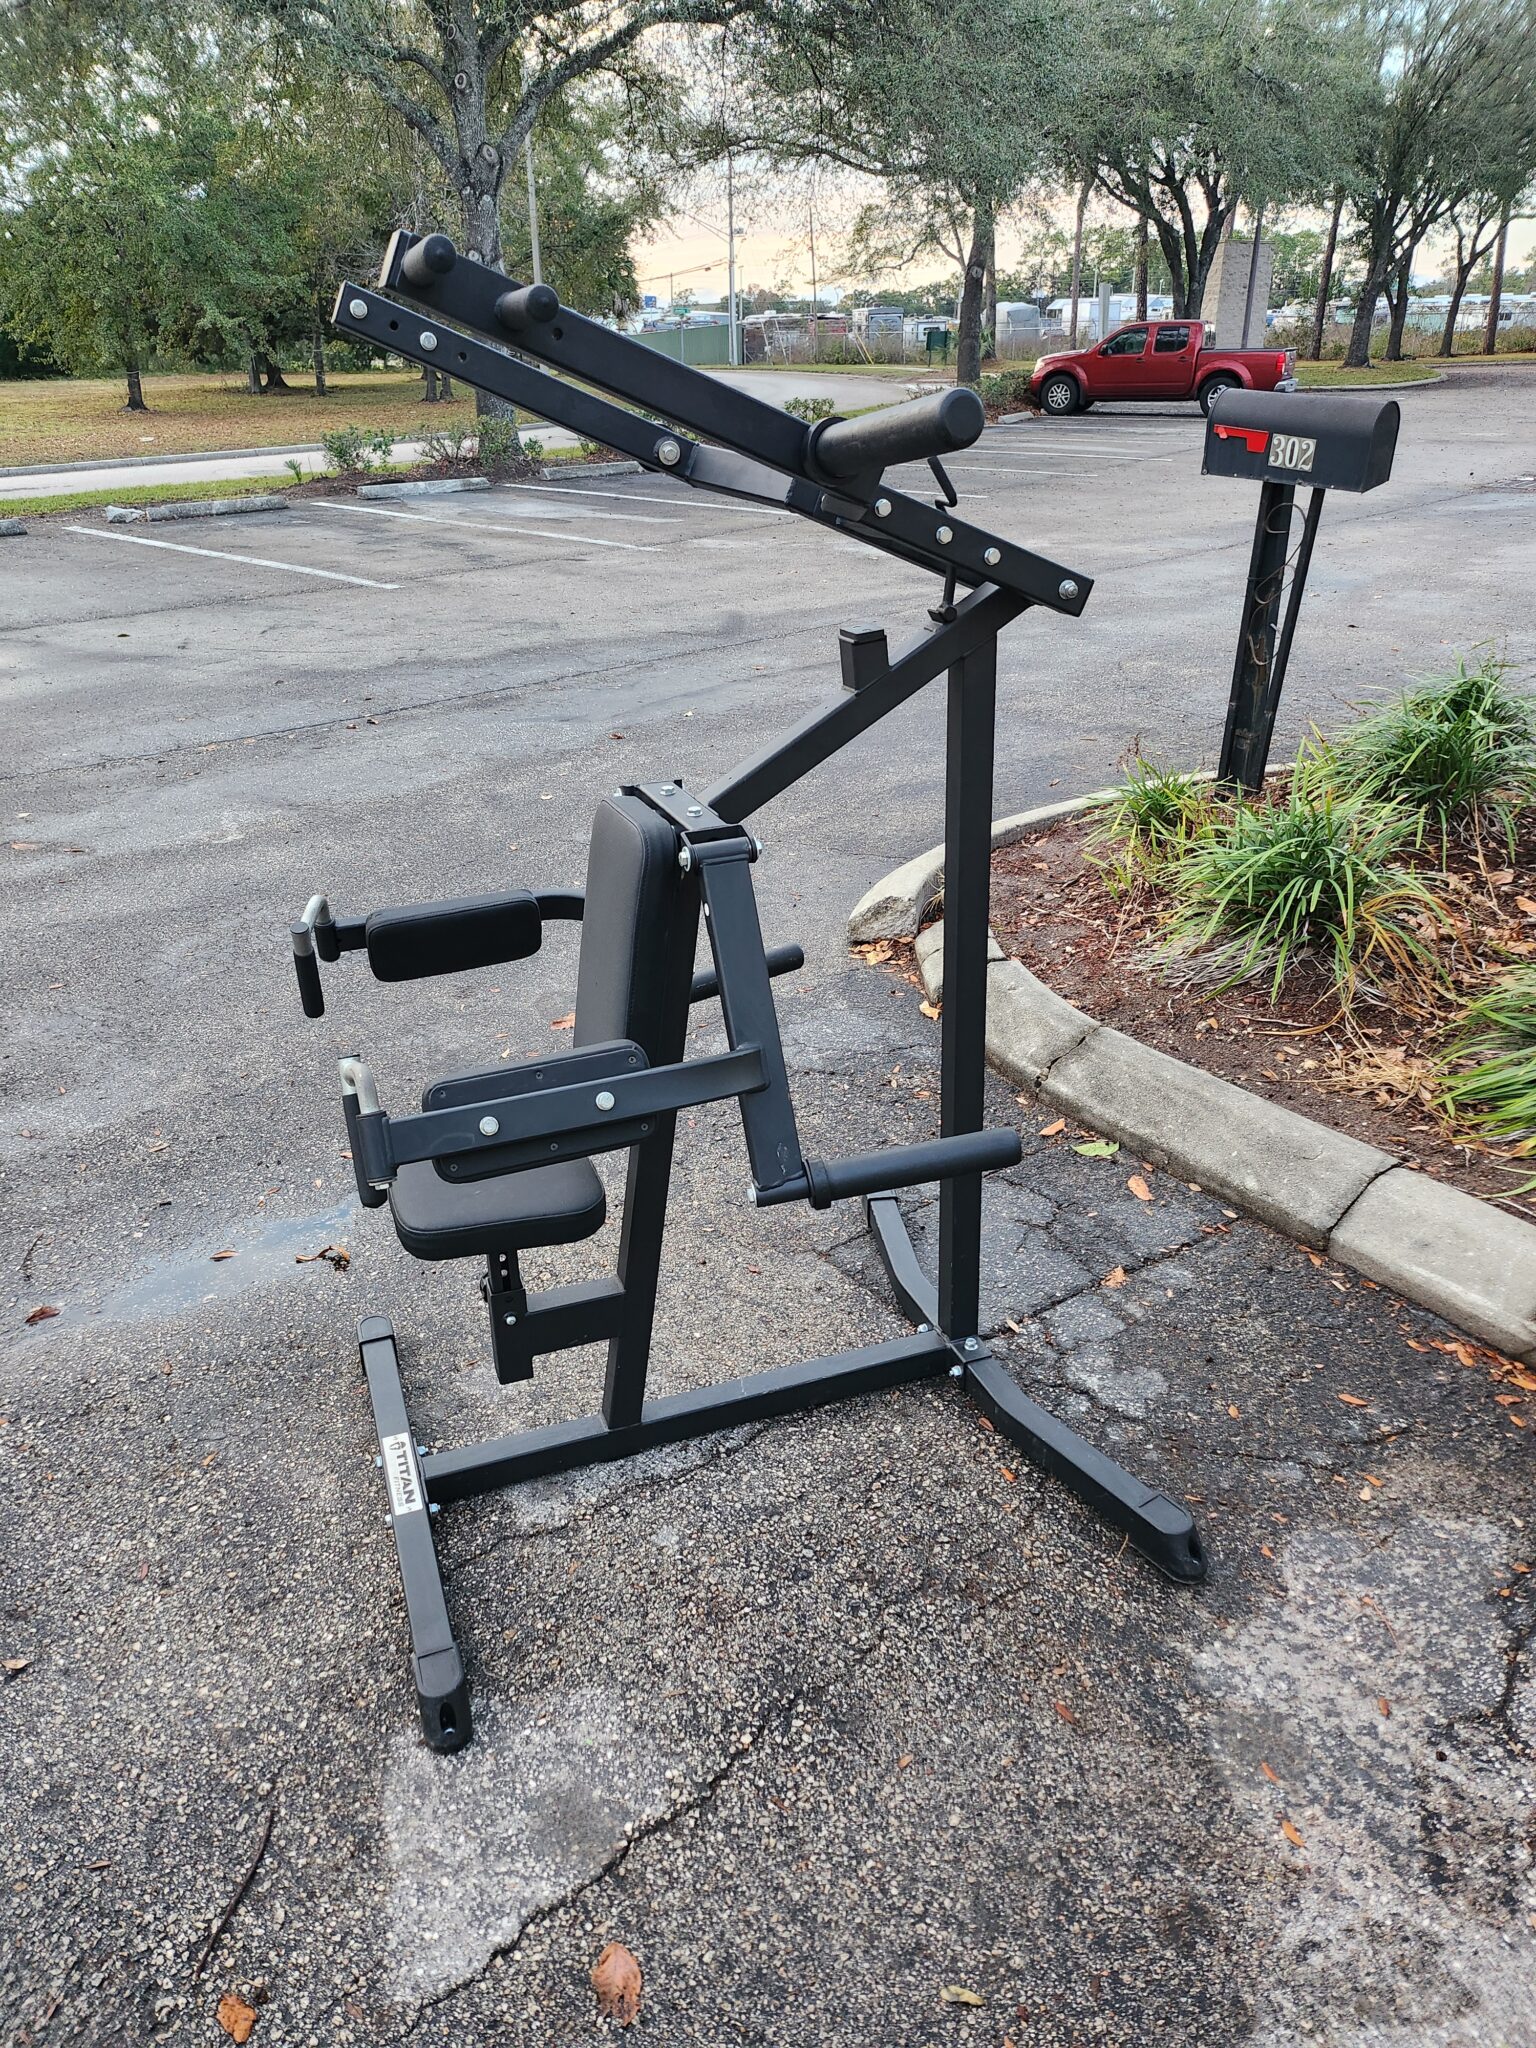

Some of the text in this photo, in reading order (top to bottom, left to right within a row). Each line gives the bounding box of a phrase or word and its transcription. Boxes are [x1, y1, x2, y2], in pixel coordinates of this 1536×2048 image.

[1269, 435, 1315, 471] 302
[392, 1476, 405, 1508] FITNESS
[396, 1450, 417, 1505] TITAN
